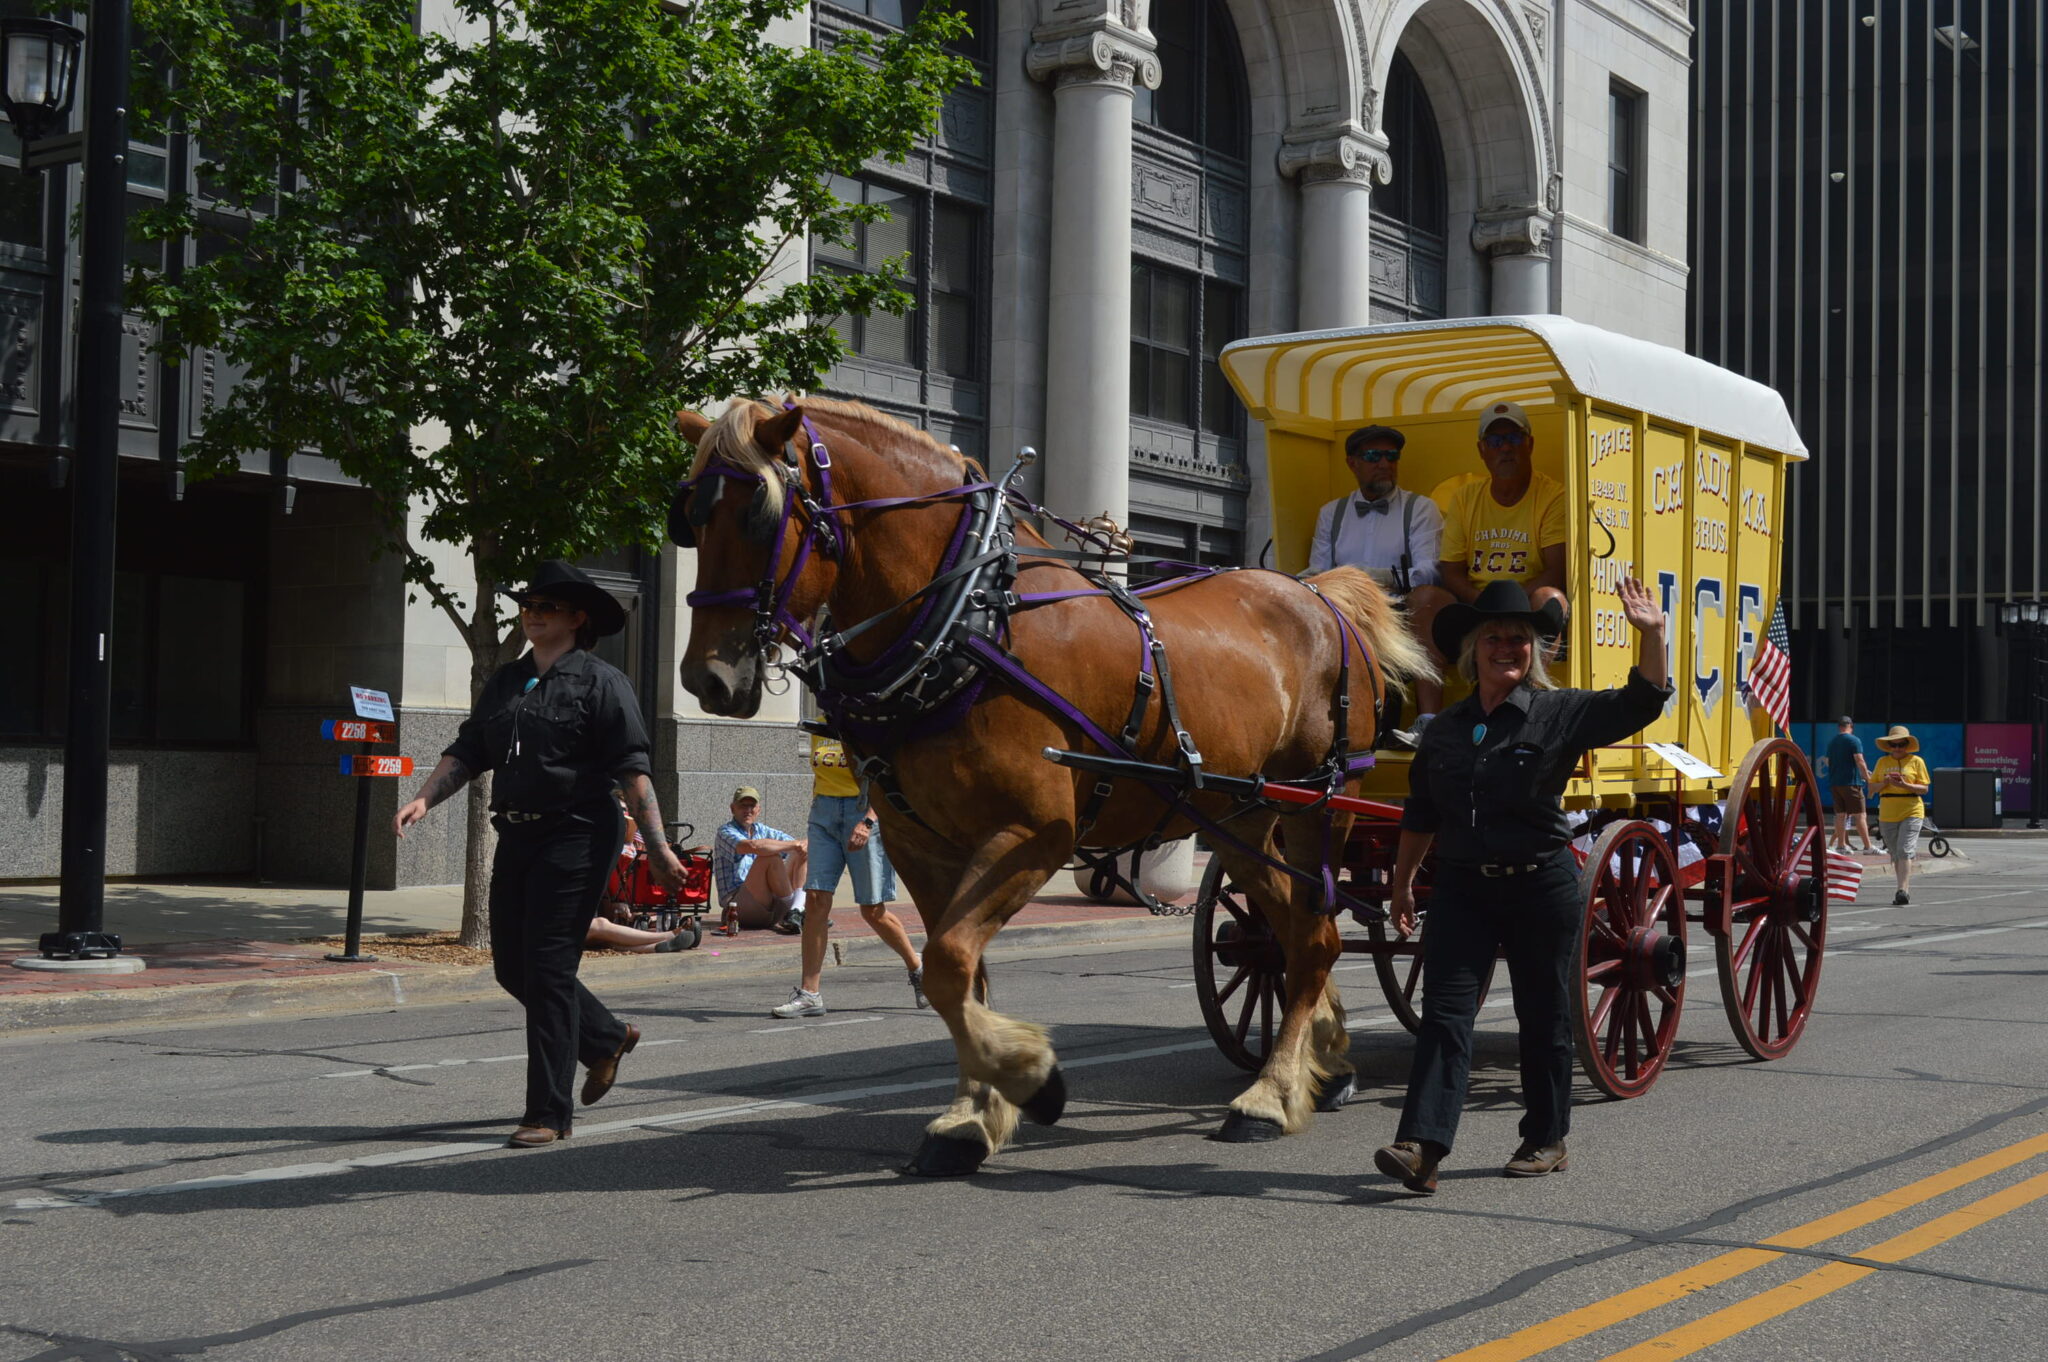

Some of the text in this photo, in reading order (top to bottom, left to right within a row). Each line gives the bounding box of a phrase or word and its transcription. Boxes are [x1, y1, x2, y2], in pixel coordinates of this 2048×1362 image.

[1471, 549, 1528, 574] ICE
[341, 722, 367, 739] 2258
[1974, 746, 1999, 754] Learn
[377, 759, 402, 774] 2259
